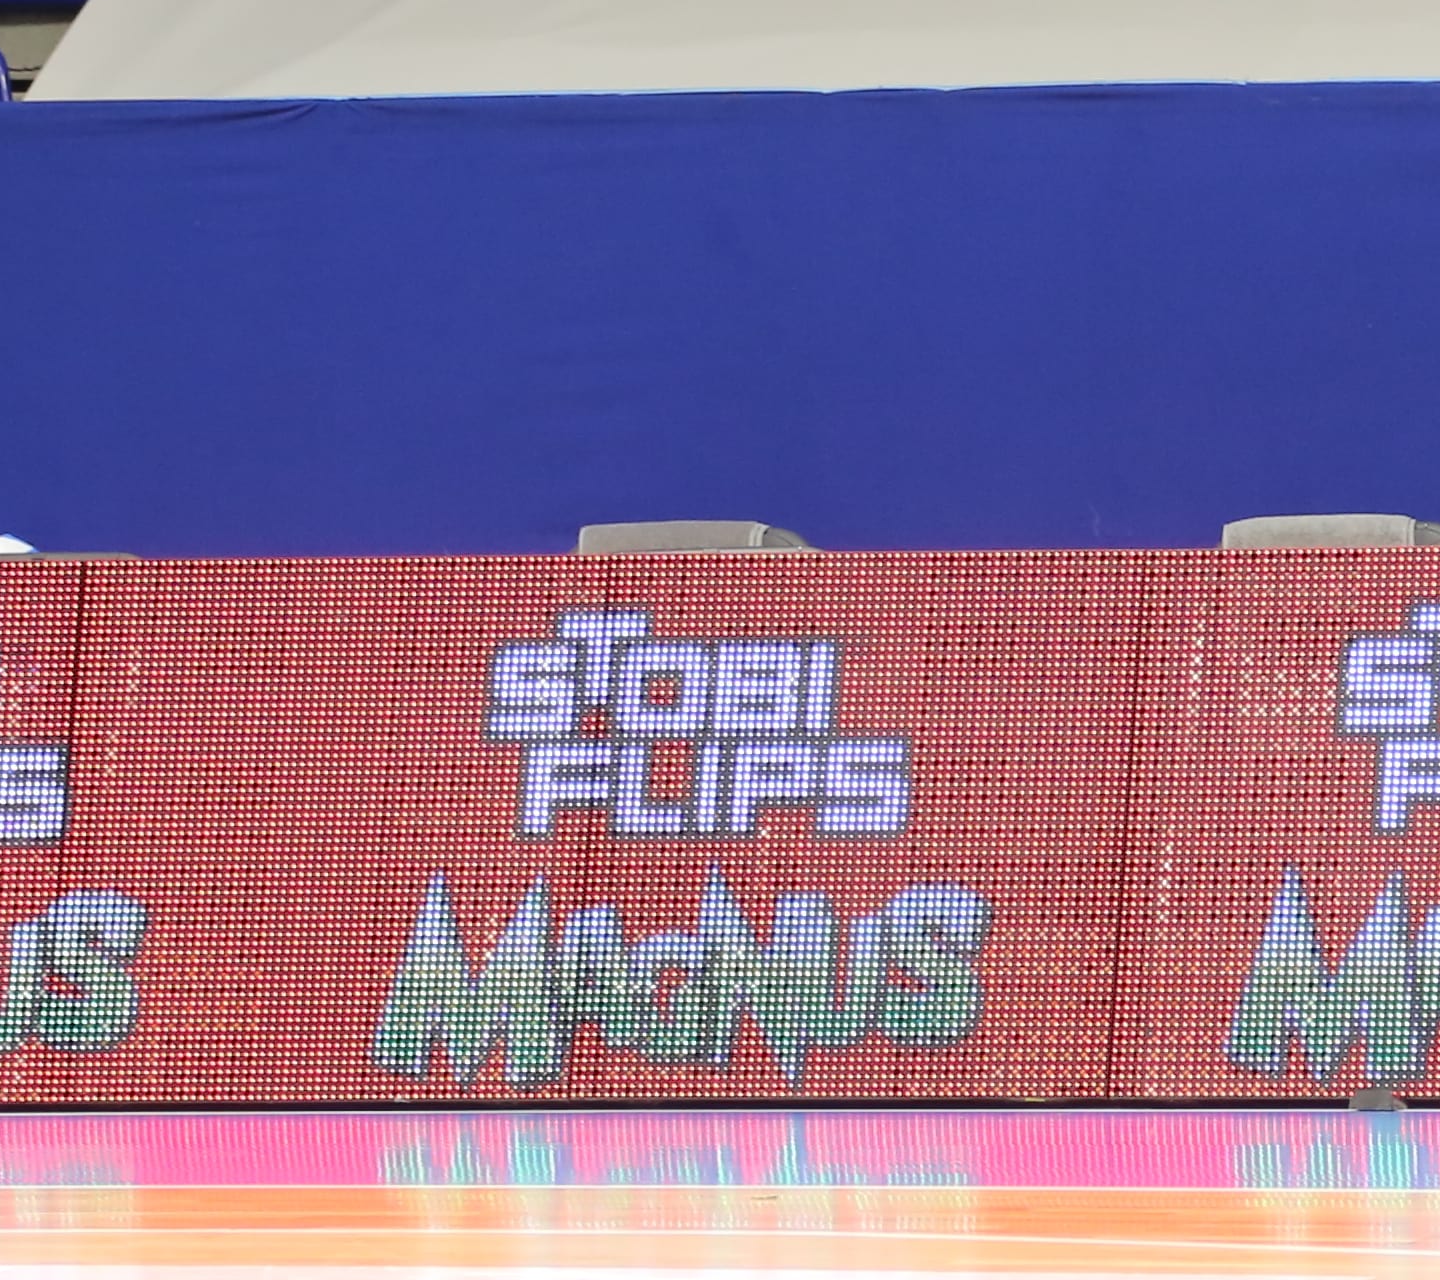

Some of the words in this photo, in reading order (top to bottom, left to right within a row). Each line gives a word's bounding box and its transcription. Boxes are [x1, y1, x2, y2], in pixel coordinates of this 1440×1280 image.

[488, 609, 838, 741] STOBI
[518, 734, 912, 839] FLIPS
[372, 863, 996, 1089] MAGNUS
